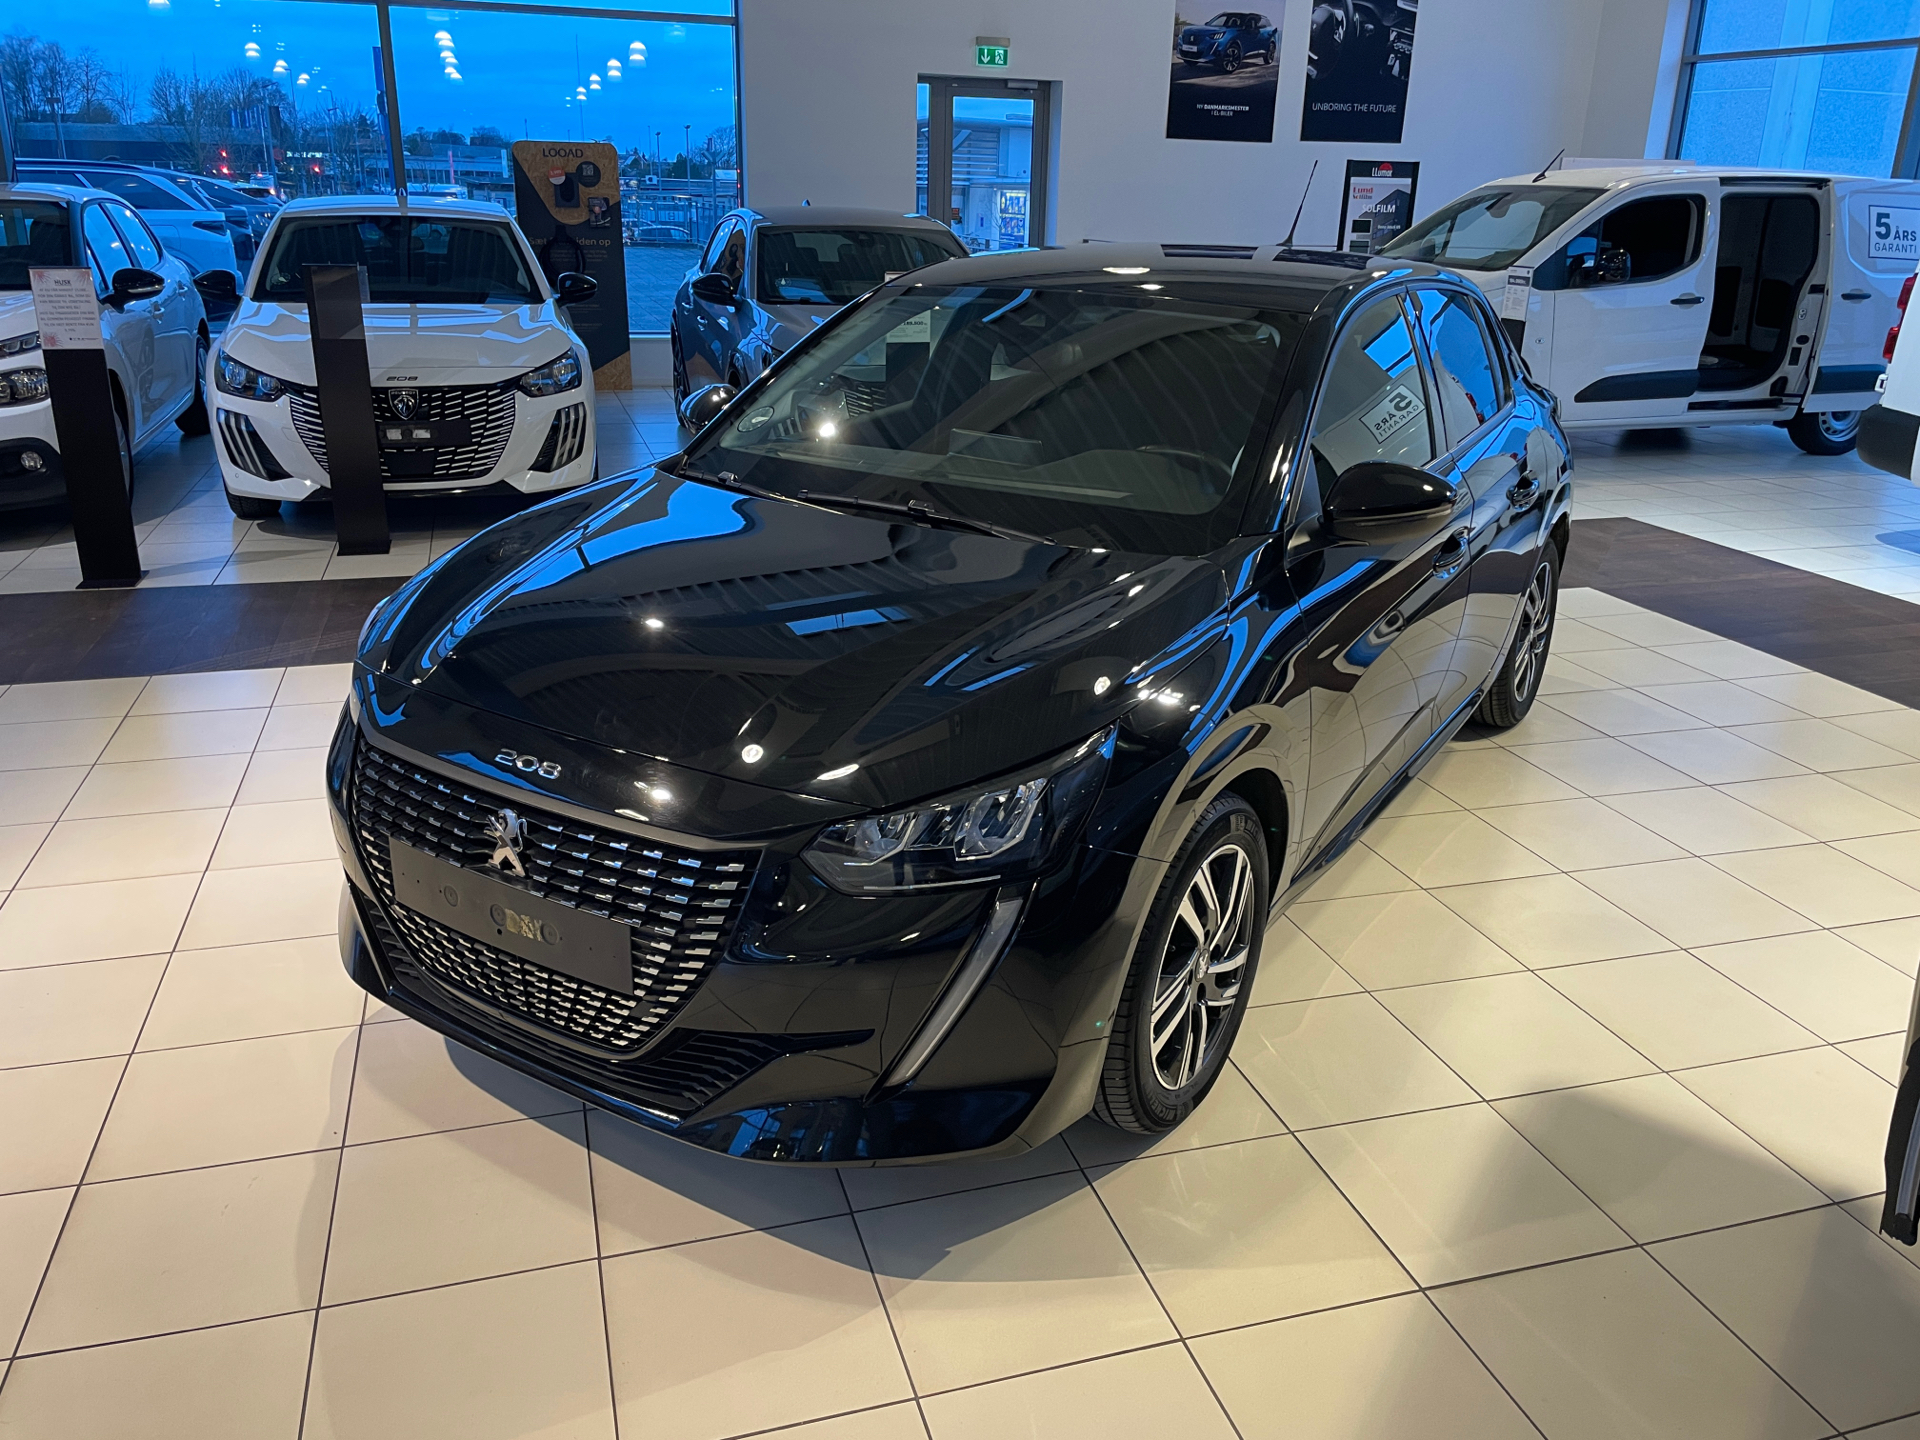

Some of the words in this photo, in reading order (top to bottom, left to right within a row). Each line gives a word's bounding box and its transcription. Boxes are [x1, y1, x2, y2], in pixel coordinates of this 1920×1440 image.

[1312, 102, 1352, 112] UNBORING
[1354, 104, 1368, 112] THE
[1370, 104, 1396, 113] FUTURE
[542, 148, 584, 158] LOOAD
[1372, 167, 1392, 177] LLumar
[1362, 204, 1396, 213] SOLFILM
[1875, 212, 1892, 240] 5
[1893, 226, 1917, 242] ÅRS
[598, 239, 611, 248] op
[1874, 242, 1917, 254] GARANTI
[494, 748, 562, 779] 208
